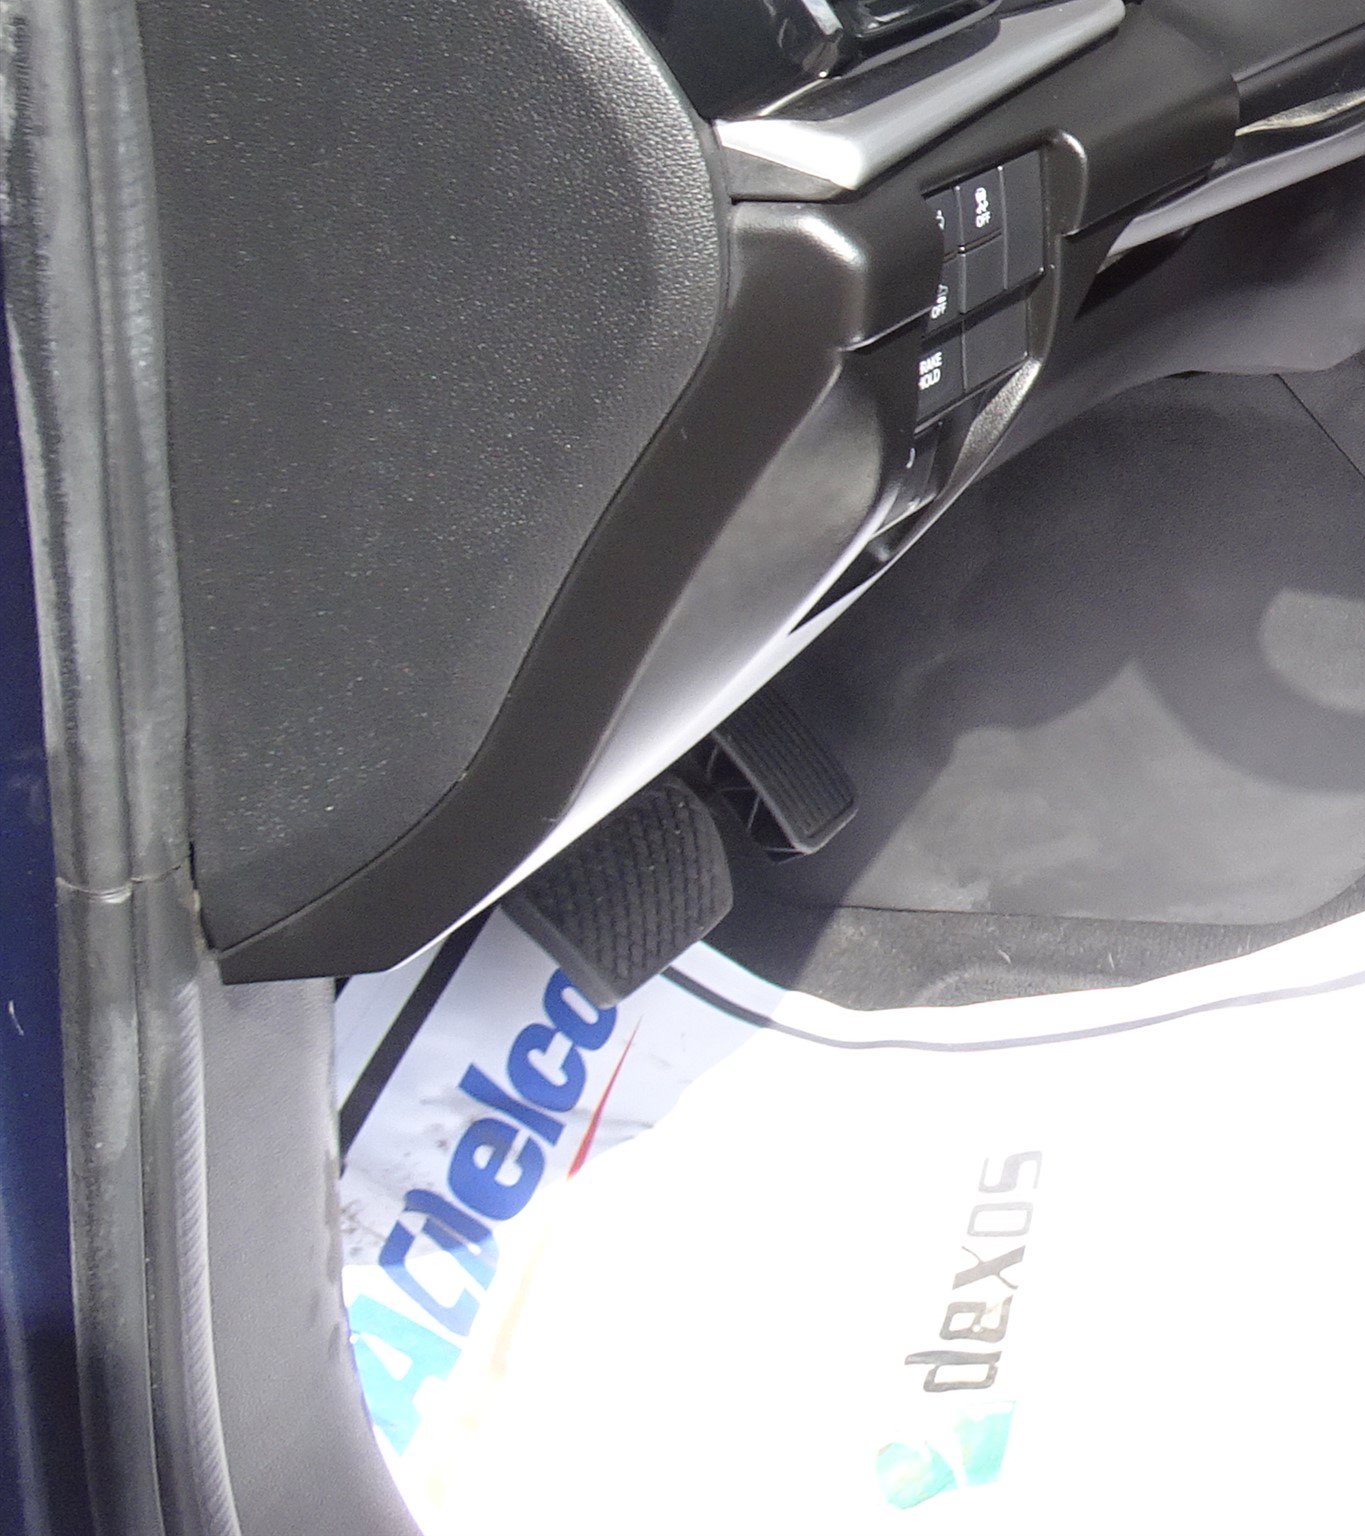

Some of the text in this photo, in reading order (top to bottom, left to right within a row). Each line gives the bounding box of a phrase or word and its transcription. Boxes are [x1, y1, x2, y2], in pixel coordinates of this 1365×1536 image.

[975, 210, 991, 228] OFF
[931, 303, 947, 319] OFF
[904, 1150, 1043, 1393] dexos
